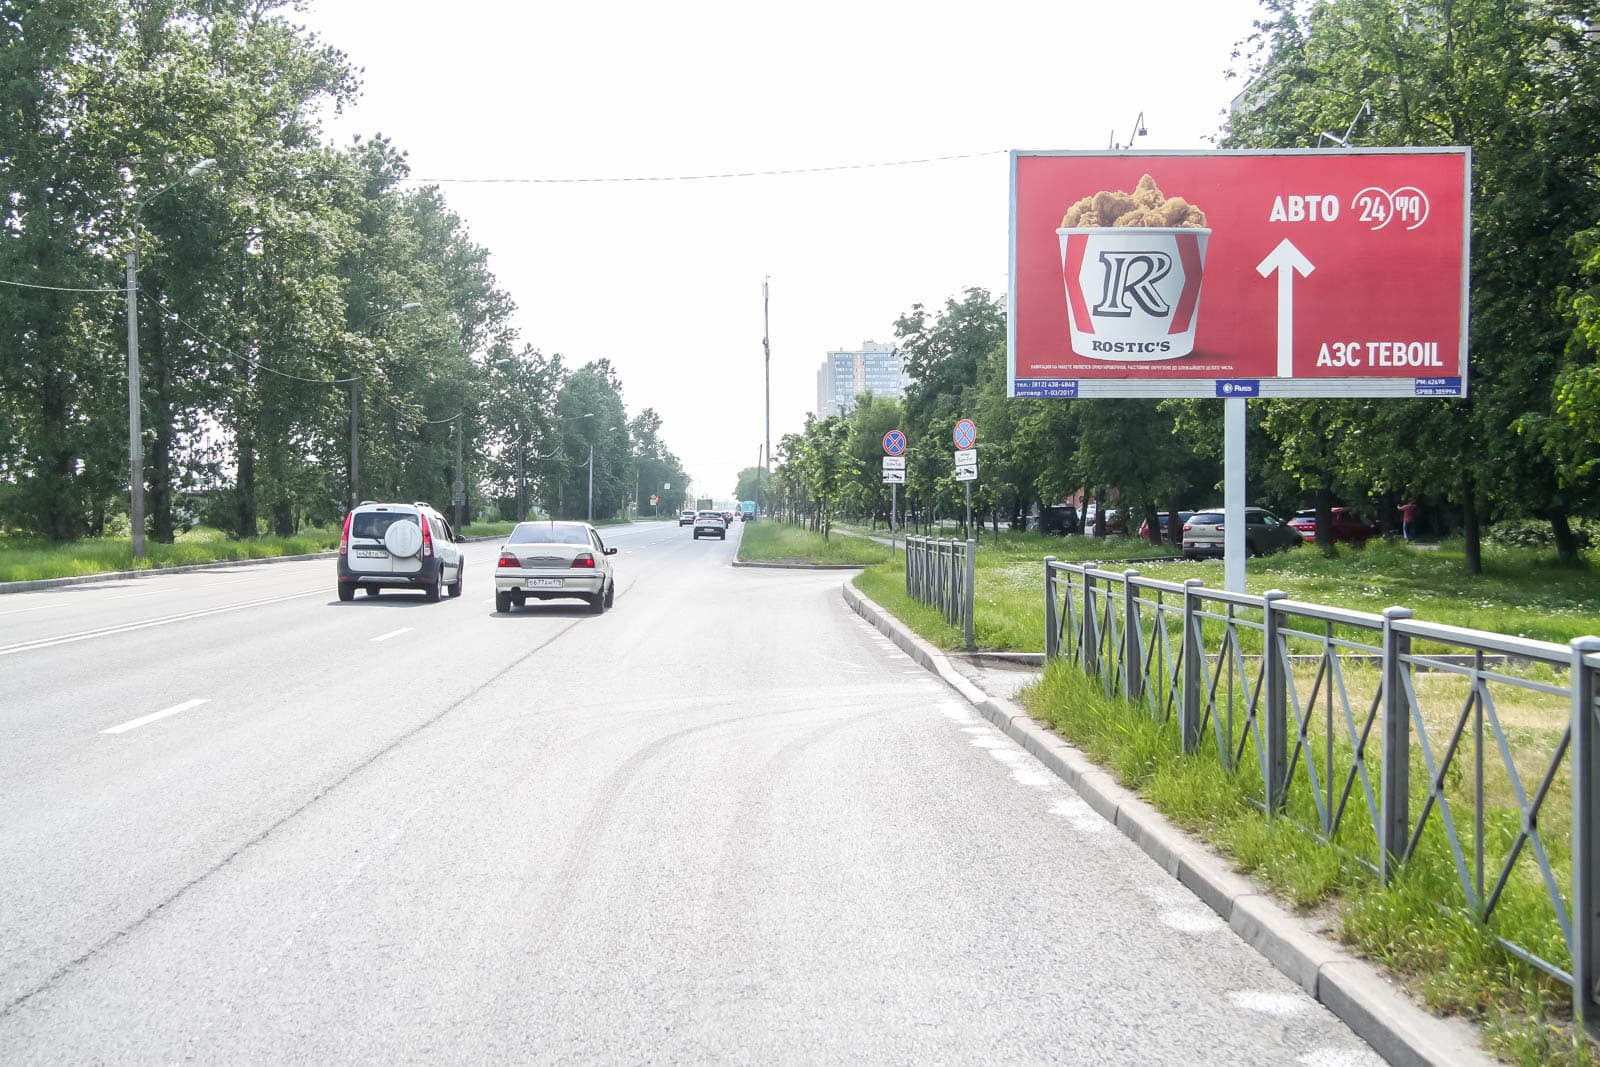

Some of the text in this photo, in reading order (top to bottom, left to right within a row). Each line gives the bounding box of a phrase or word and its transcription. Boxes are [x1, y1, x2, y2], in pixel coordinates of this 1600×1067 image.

[1268, 195, 1386, 223] АВТО 24
[1092, 251, 1173, 318] R
[1092, 340, 1171, 353] ROSTIC'S
[1316, 341, 1443, 367] АЗС TEBOIL
[1234, 384, 1253, 392] Russ
